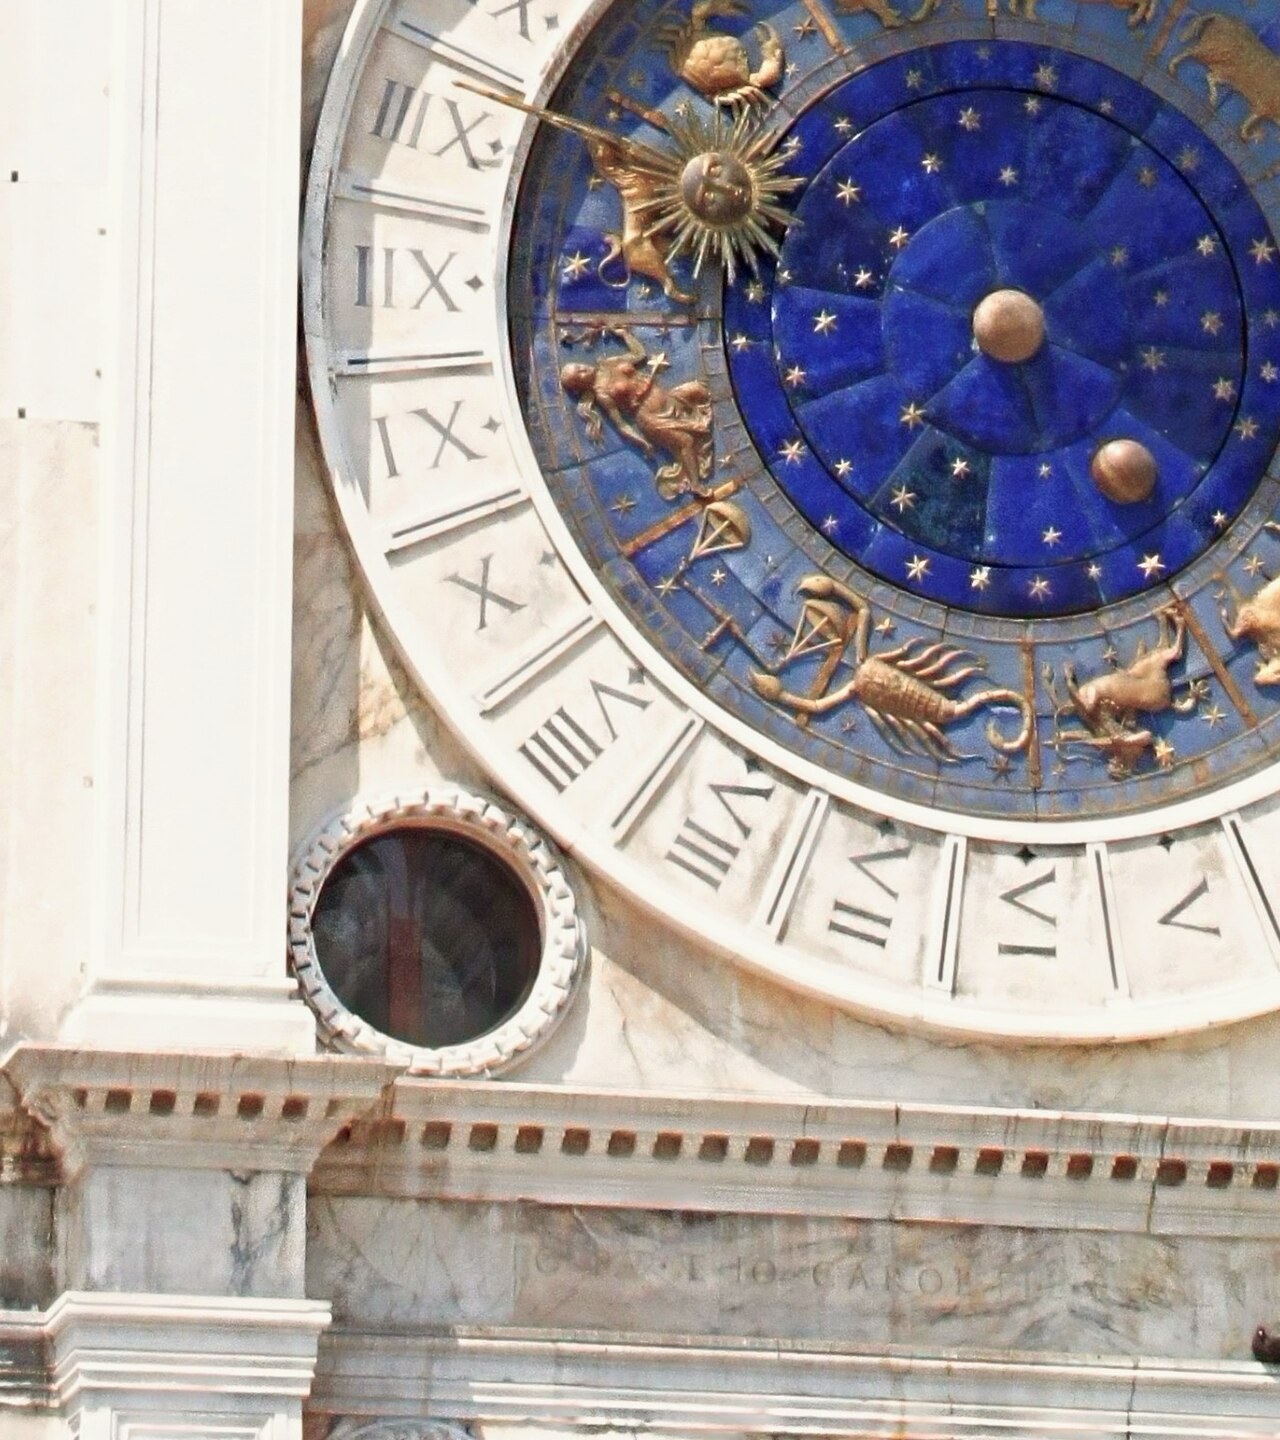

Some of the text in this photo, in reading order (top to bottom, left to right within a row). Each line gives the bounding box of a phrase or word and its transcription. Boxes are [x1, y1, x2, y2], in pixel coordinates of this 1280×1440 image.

[354, 244, 461, 312] XII
[372, 400, 487, 478] XI
[444, 552, 527, 630] X
[517, 679, 653, 795] VIIII
[664, 783, 774, 892] VIII
[828, 845, 911, 948] VII
[997, 866, 1057, 958] VI
[1157, 875, 1222, 938] V
